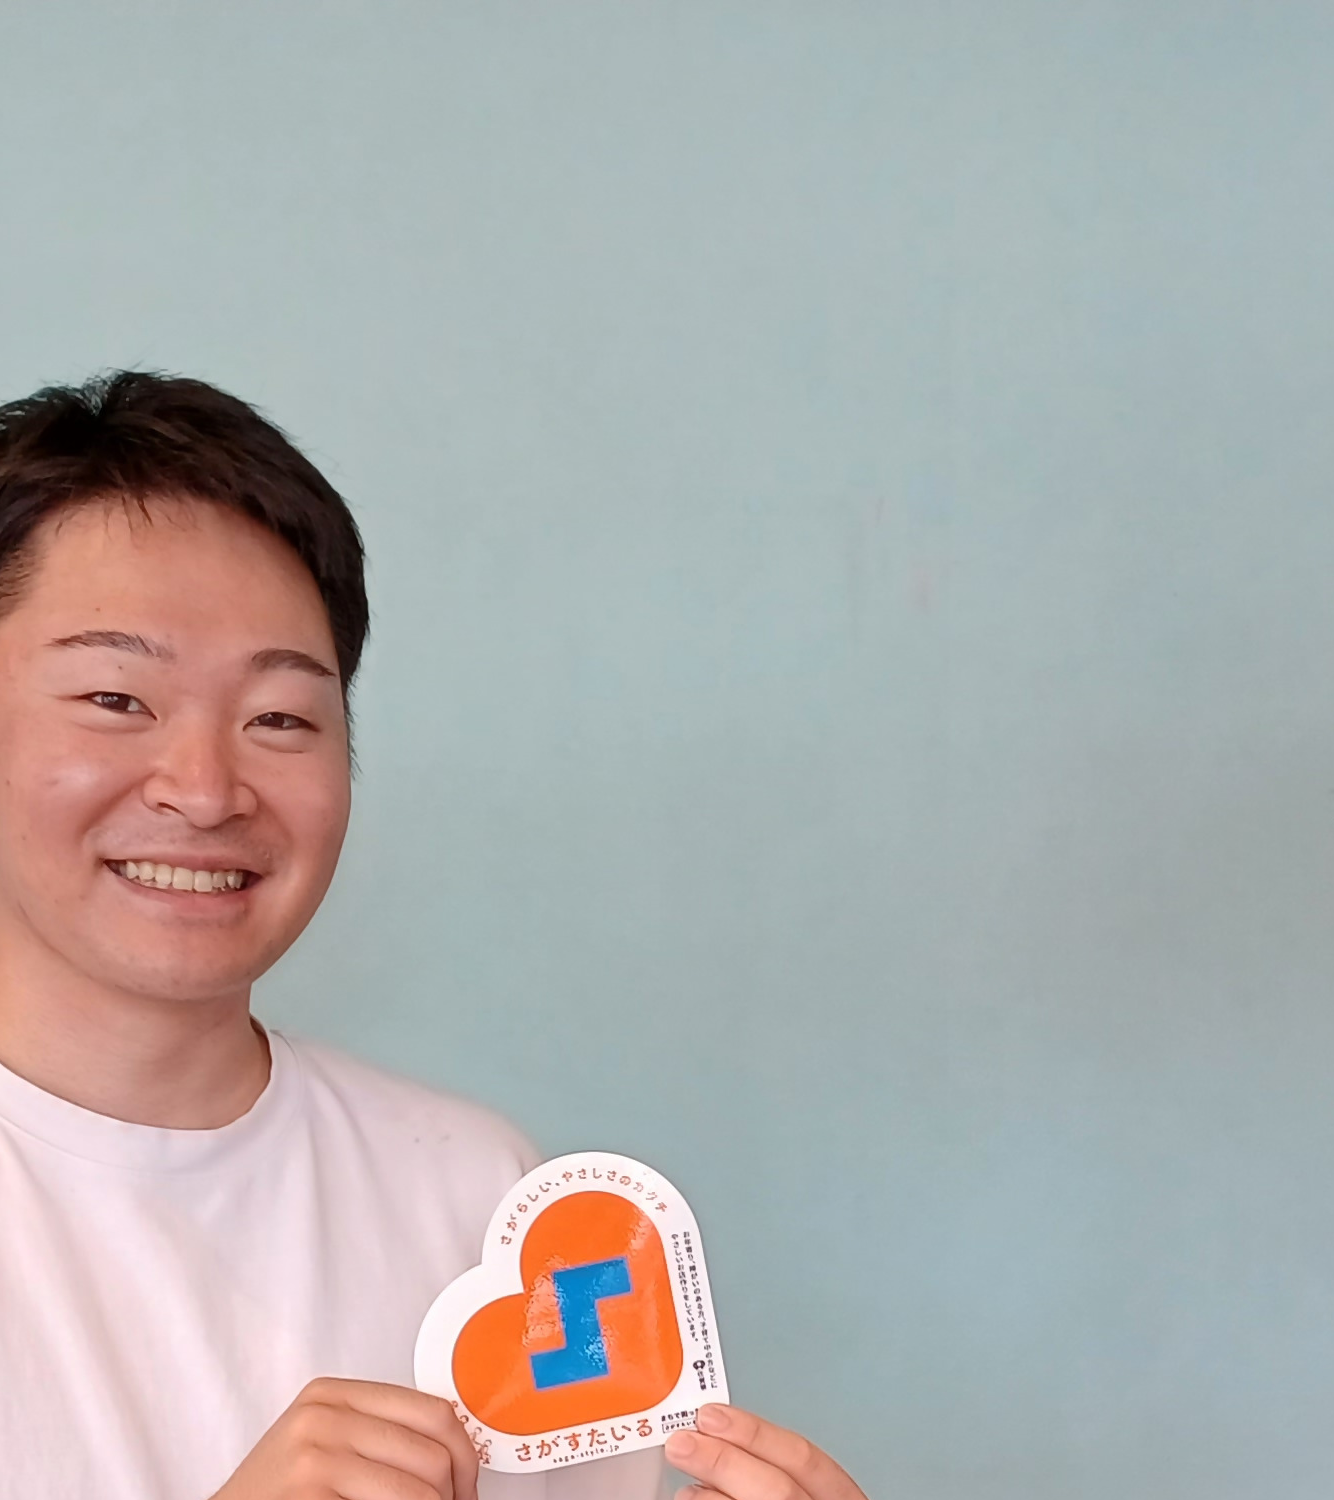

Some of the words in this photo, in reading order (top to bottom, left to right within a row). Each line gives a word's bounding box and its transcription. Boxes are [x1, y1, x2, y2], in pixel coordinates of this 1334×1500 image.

[514, 1418, 653, 1462] さがすたいる
